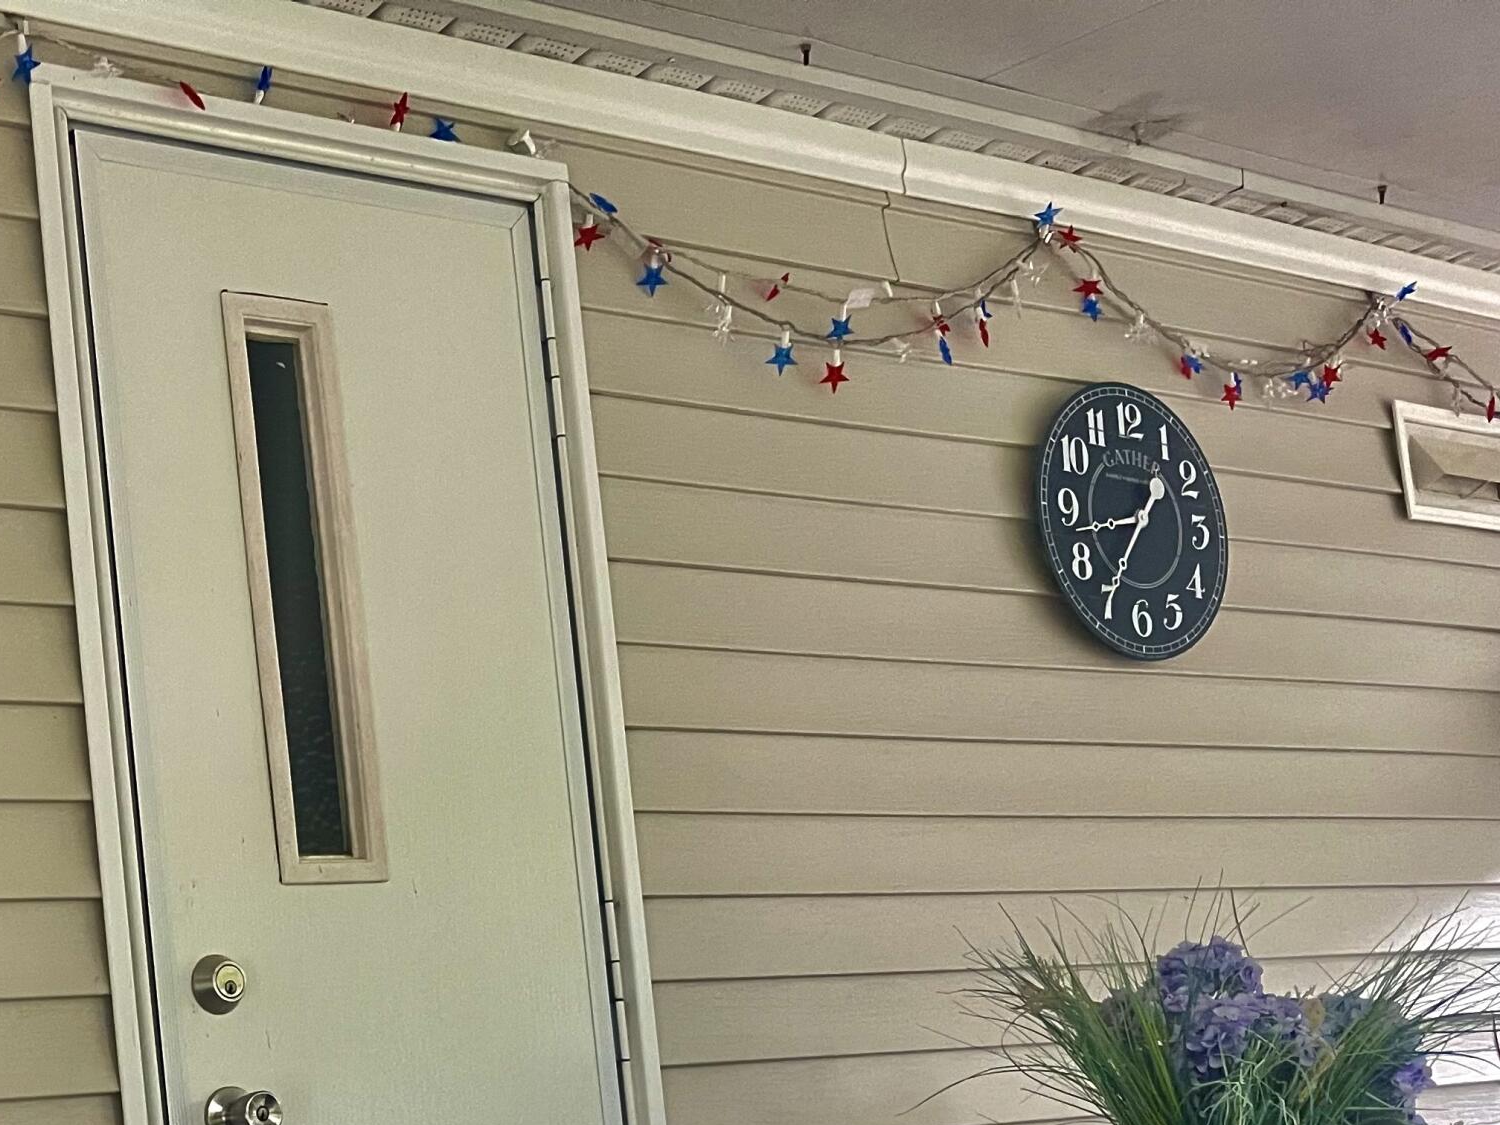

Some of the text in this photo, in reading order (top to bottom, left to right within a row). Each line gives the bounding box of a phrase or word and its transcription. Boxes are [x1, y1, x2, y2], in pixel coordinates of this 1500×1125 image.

[1086, 407, 1106, 448] 11
[1116, 402, 1145, 441] 12
[1060, 434, 1089, 476] 10
[1158, 423, 1170, 461] 1
[1178, 460, 1200, 500] 2
[1057, 487, 1079, 527] 9
[1190, 514, 1210, 550] 3
[1072, 542, 1093, 581] 8
[1101, 582, 1121, 620] 7
[1185, 563, 1206, 600] 4
[1132, 599, 1153, 638] 6
[1163, 593, 1183, 631] 5
